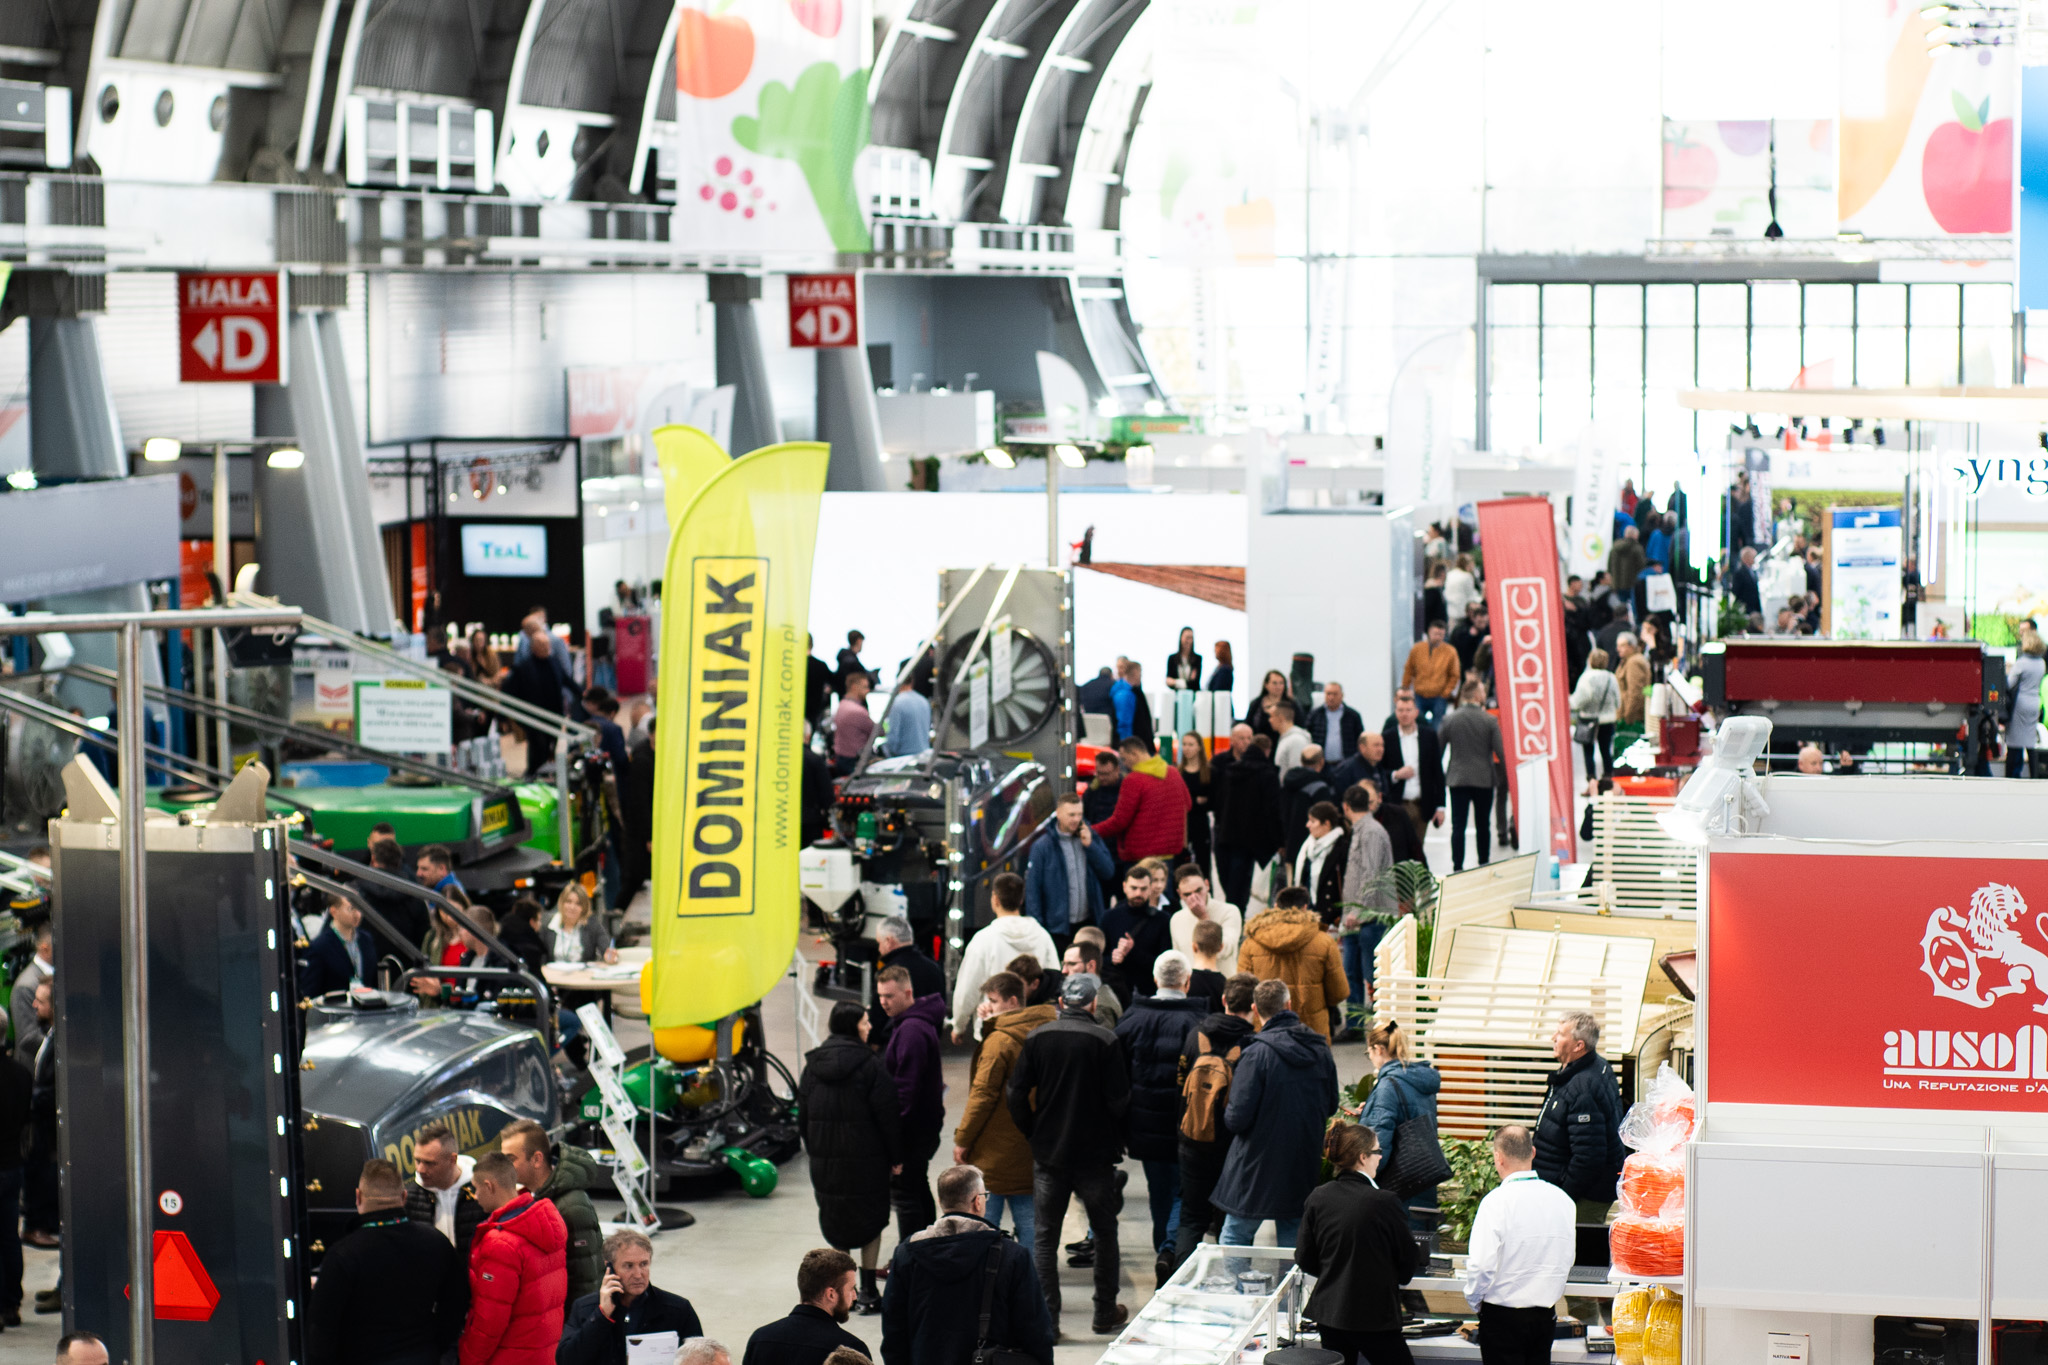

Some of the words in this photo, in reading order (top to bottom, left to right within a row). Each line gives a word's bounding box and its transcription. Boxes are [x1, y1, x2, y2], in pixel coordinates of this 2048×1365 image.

[187, 278, 271, 308] HALA
[792, 280, 852, 301] HALA
[221, 315, 270, 373] D
[818, 304, 852, 344] D
[689, 572, 756, 899] DOMINIAK
[772, 624, 799, 849] www.dominiak.com.pl
[164, 1198, 177, 1209] 15
